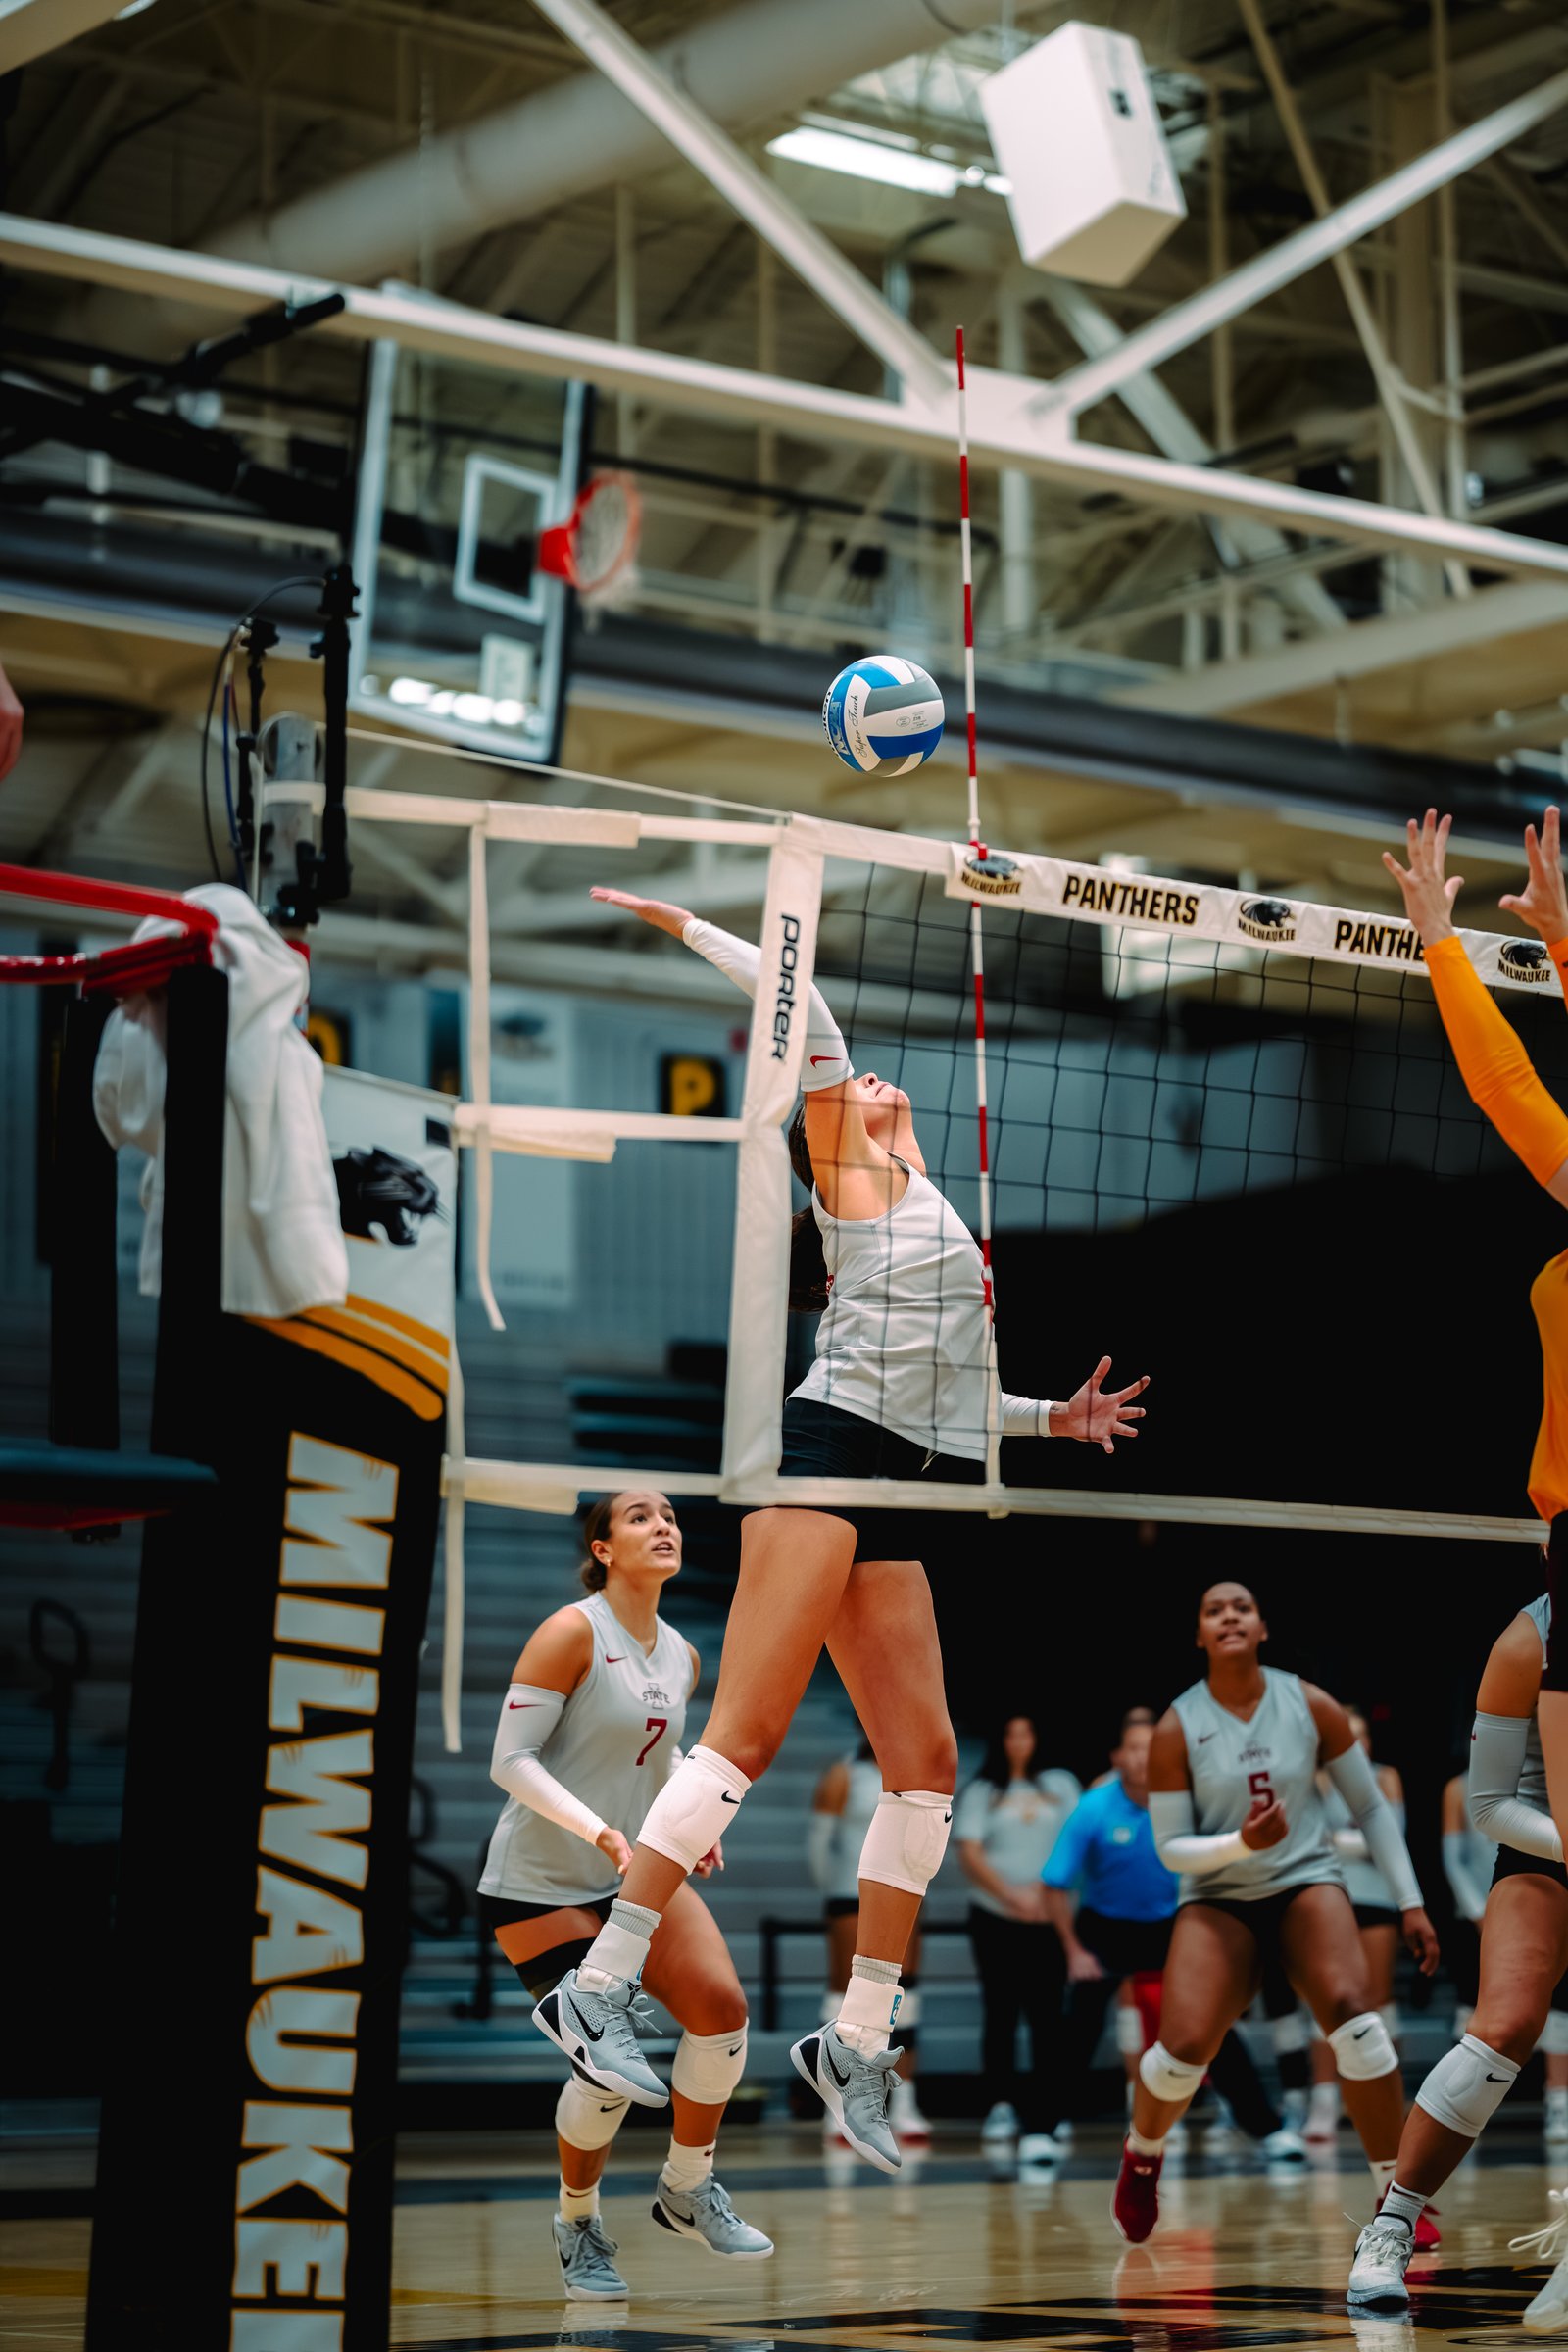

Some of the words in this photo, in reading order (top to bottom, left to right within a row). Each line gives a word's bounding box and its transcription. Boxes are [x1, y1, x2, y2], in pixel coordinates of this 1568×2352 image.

[848, 695, 859, 727] Touch
[856, 730, 868, 758] Super
[1062, 874, 1200, 925] PANTHERS
[1238, 918, 1297, 943] MILWAUKEE
[1334, 918, 1426, 962] PANTHE
[1498, 957, 1551, 983] MILWAUKEE
[642, 1690, 671, 1705] STATE
[635, 1717, 668, 1767] 7
[1248, 1771, 1276, 1811] 5
